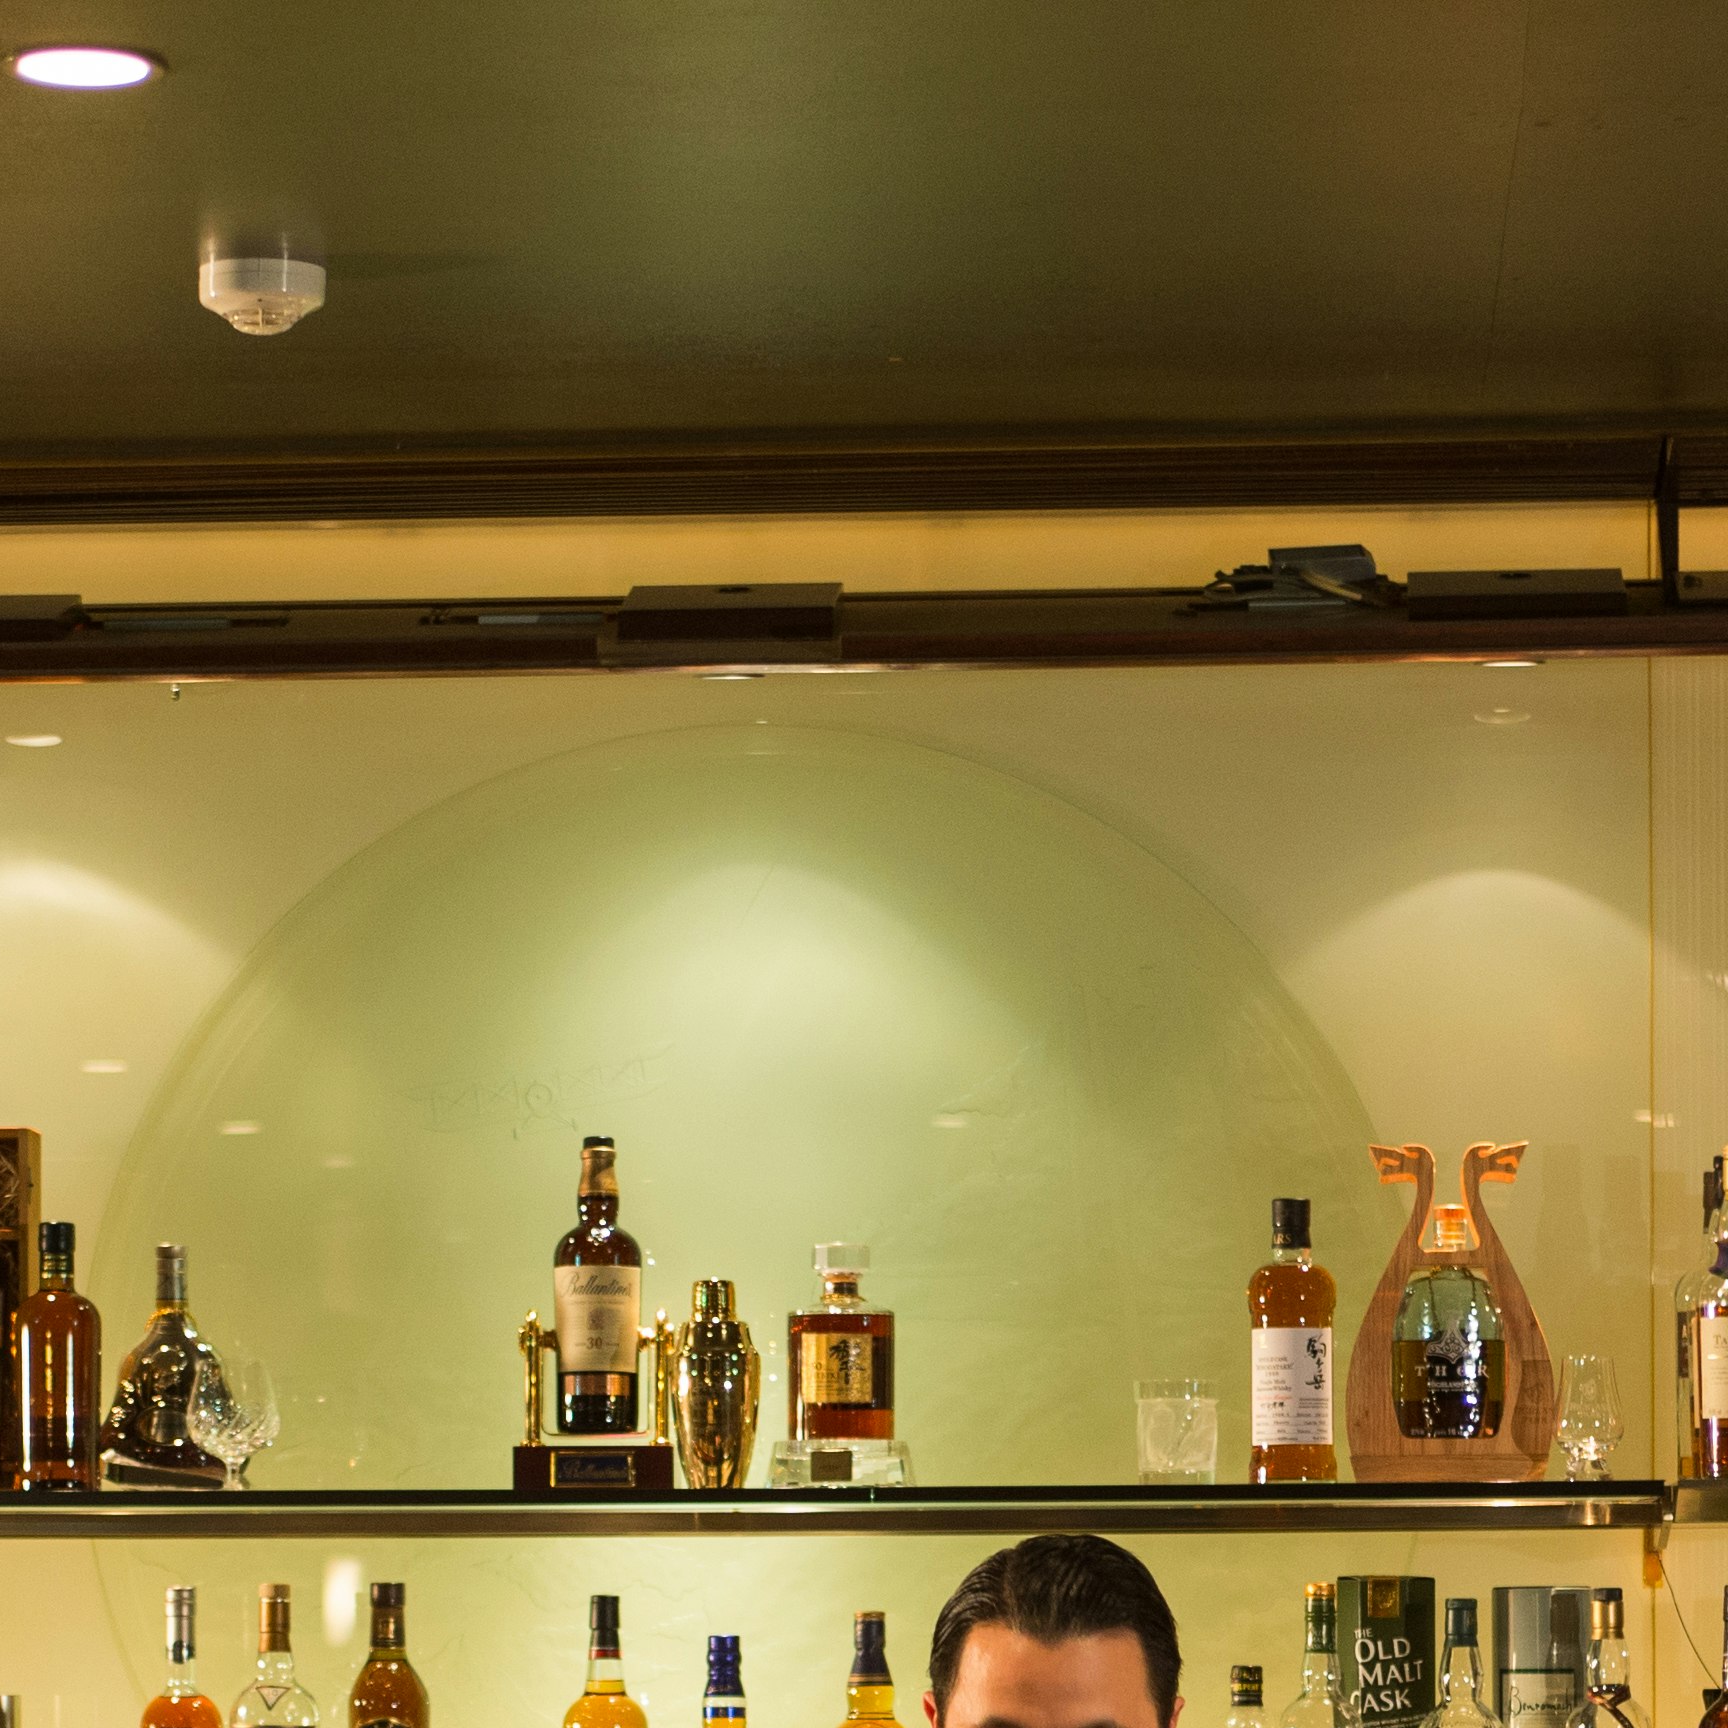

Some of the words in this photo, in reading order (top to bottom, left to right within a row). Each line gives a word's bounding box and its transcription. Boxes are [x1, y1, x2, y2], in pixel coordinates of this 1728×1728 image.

[586, 1337, 603, 1350] 30
[1354, 1627, 1374, 1640] THE
[1354, 1637, 1412, 1664] OLD
[1358, 1660, 1424, 1689] MALT
[1350, 1688, 1413, 1714] CASK
